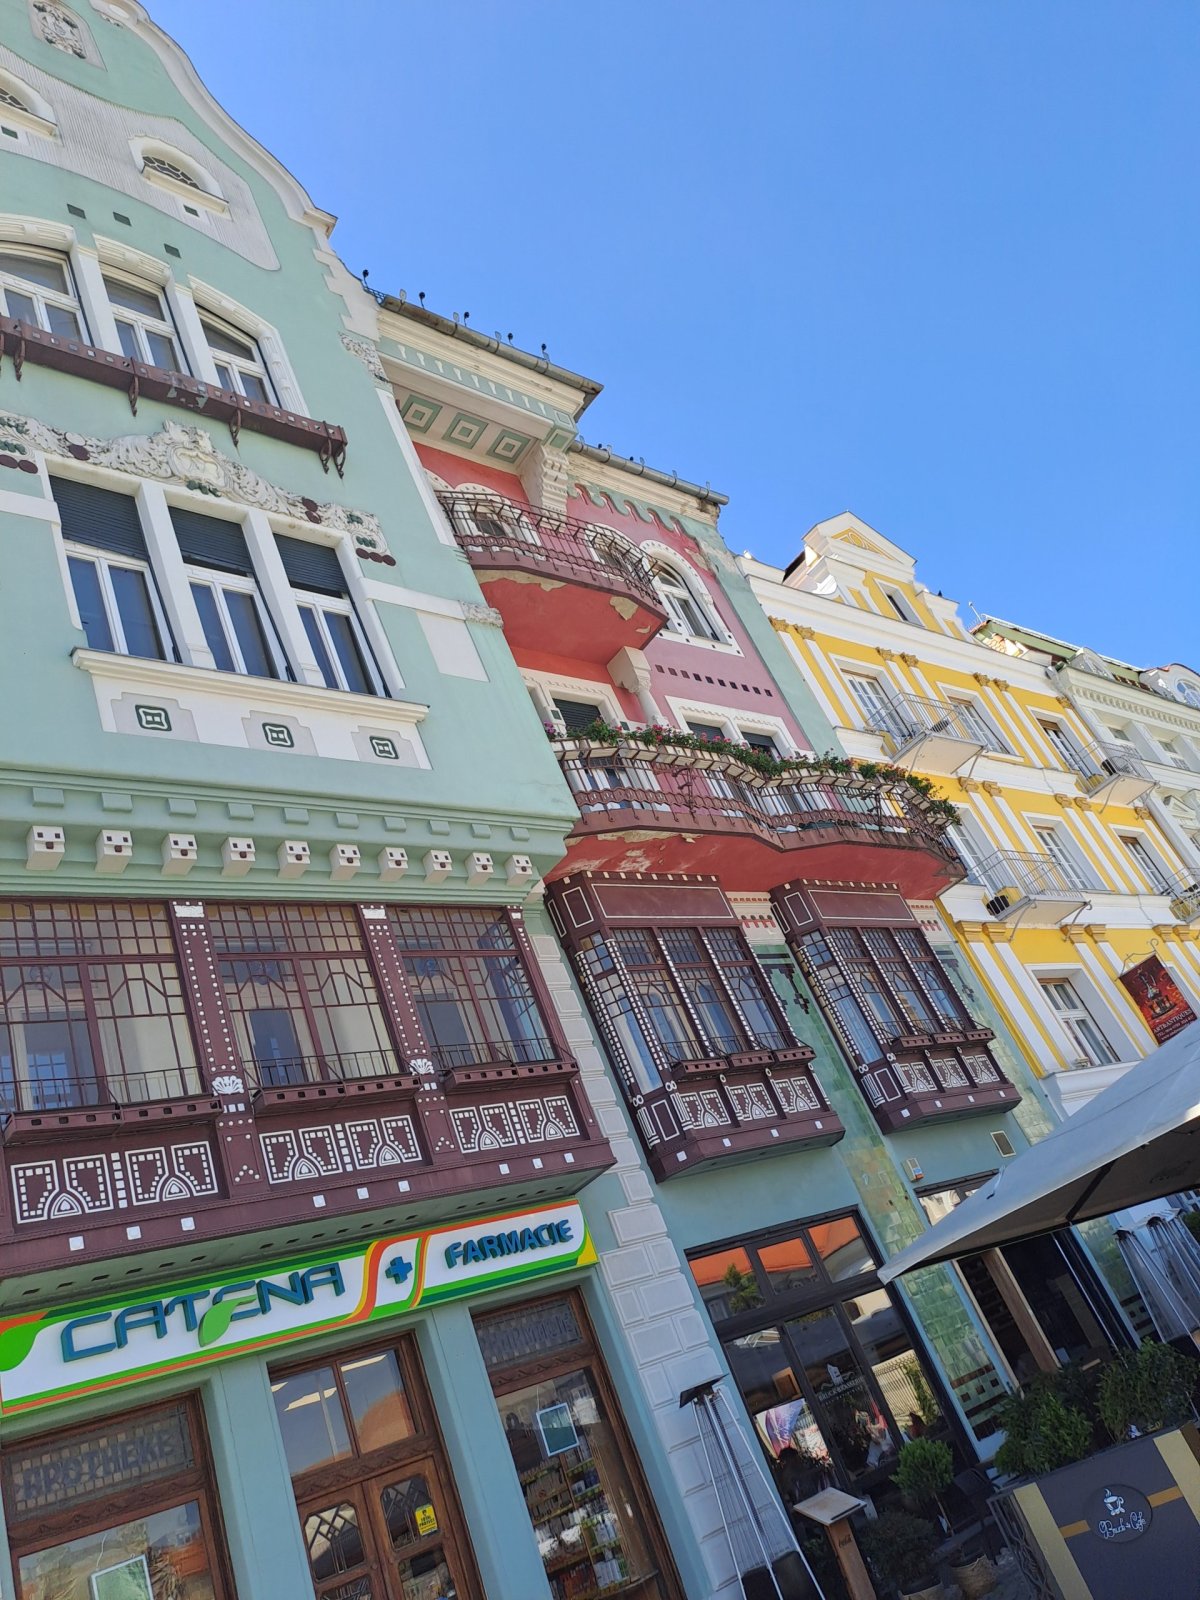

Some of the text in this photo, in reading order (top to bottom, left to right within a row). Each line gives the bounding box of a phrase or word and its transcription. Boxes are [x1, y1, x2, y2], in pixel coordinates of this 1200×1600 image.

[62, 1218, 574, 1363] CATENA FARMACIE
[22, 1429, 178, 1501] APOTHEKE
